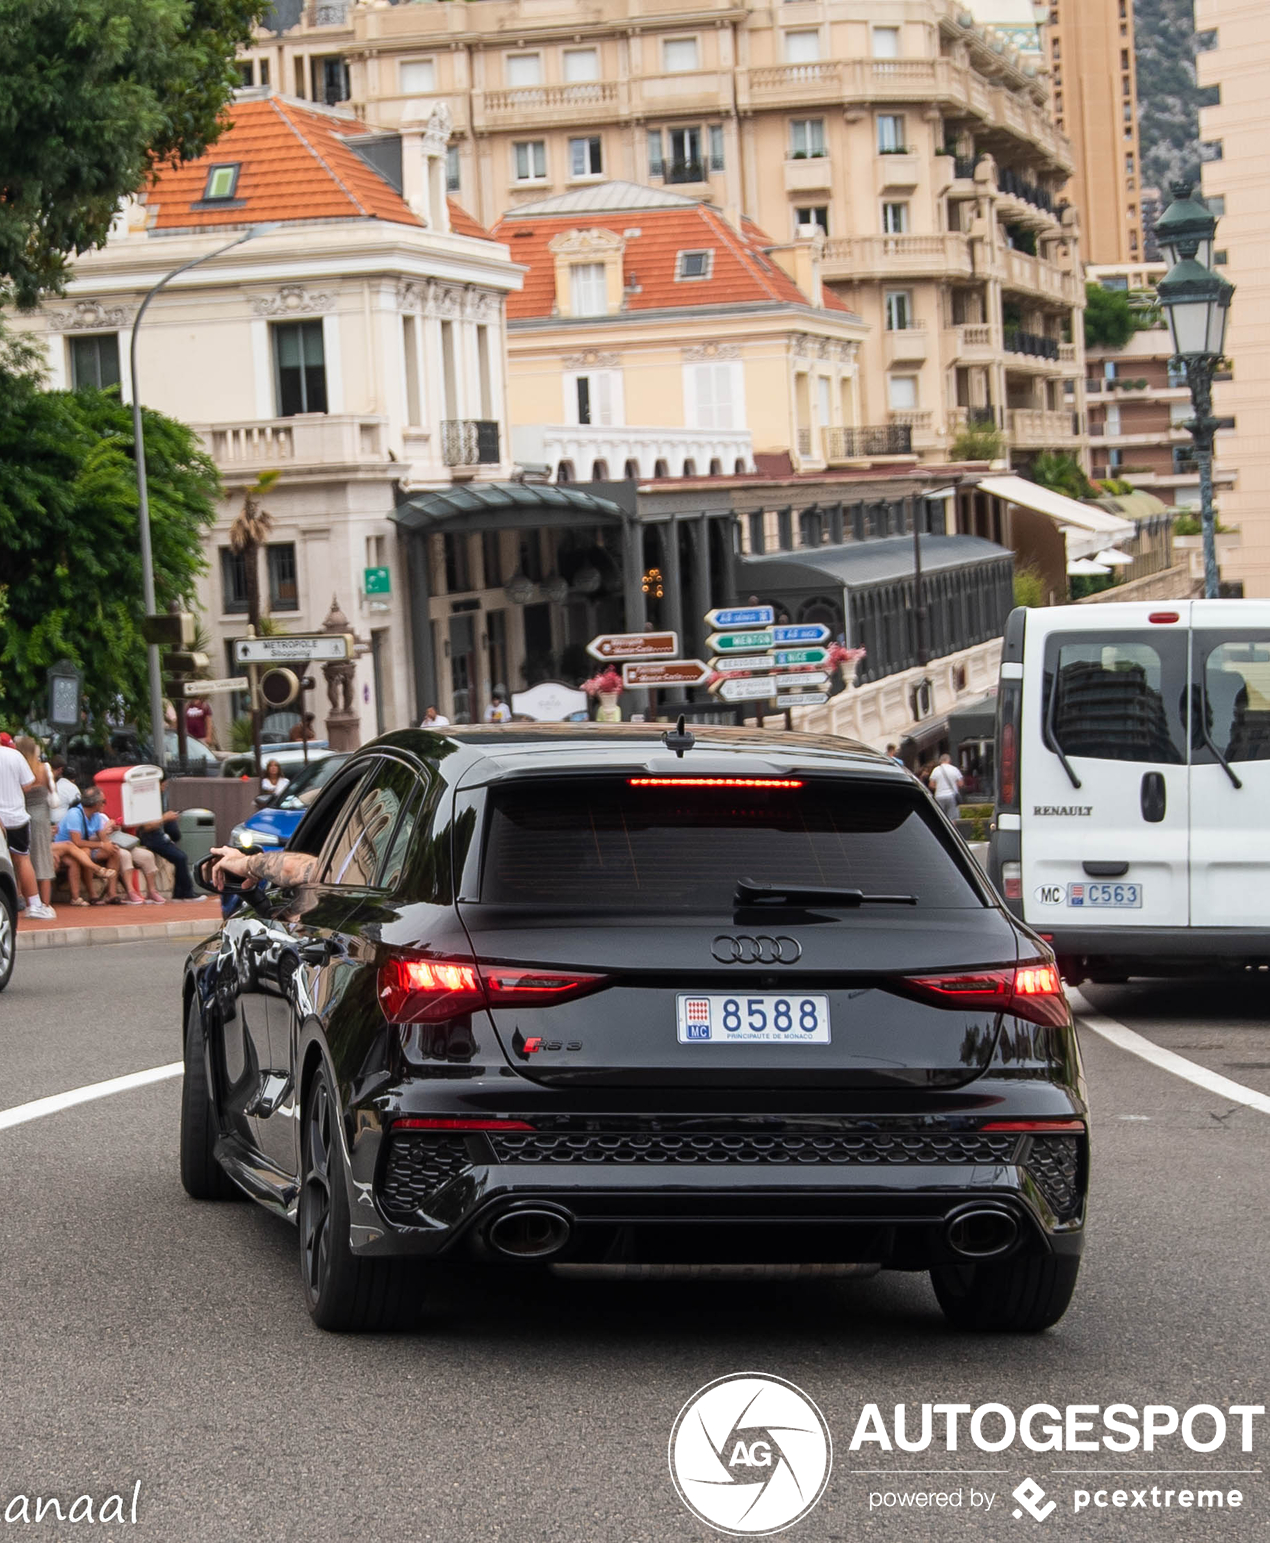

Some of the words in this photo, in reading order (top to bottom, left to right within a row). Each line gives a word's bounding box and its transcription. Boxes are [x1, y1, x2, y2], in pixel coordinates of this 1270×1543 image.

[262, 640, 318, 649] METROPOLE
[732, 635, 771, 646] MENTON
[271, 650, 311, 658] Shopping
[787, 652, 807, 662] NICE
[1033, 806, 1093, 816] RENAULT
[1041, 887, 1060, 902] MC
[1088, 885, 1137, 903] C563
[723, 998, 819, 1032] 8588
[691, 1026, 708, 1037] MC
[533, 1041, 563, 1051] RS
[566, 1041, 583, 1051] 3
